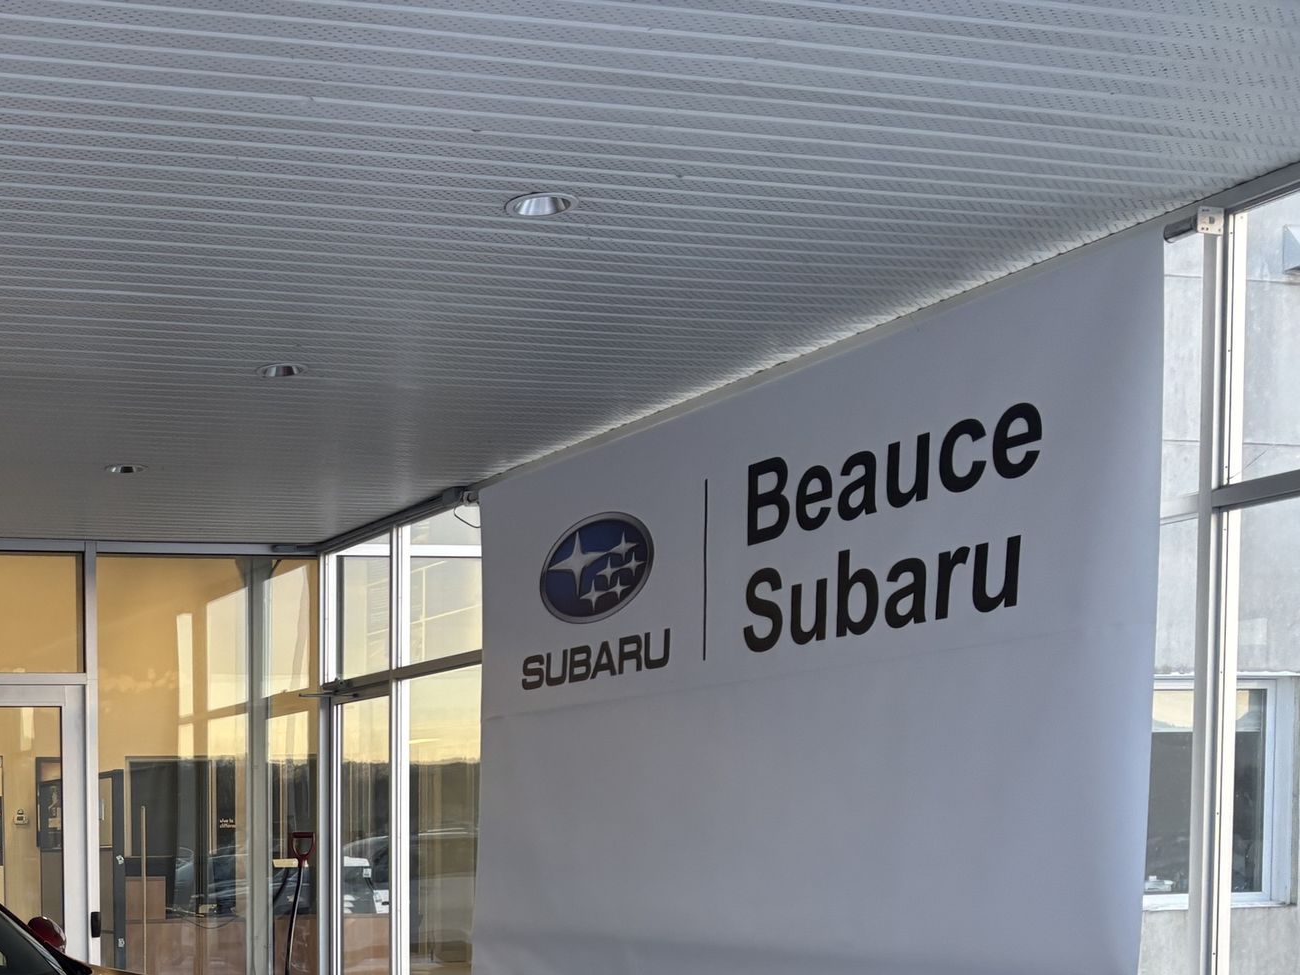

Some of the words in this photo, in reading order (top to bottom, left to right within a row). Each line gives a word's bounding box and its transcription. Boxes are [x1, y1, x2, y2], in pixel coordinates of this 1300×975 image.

[746, 402, 1043, 547] Beauce
[742, 534, 1022, 653] Subaru
[521, 628, 671, 691] SUBARU
